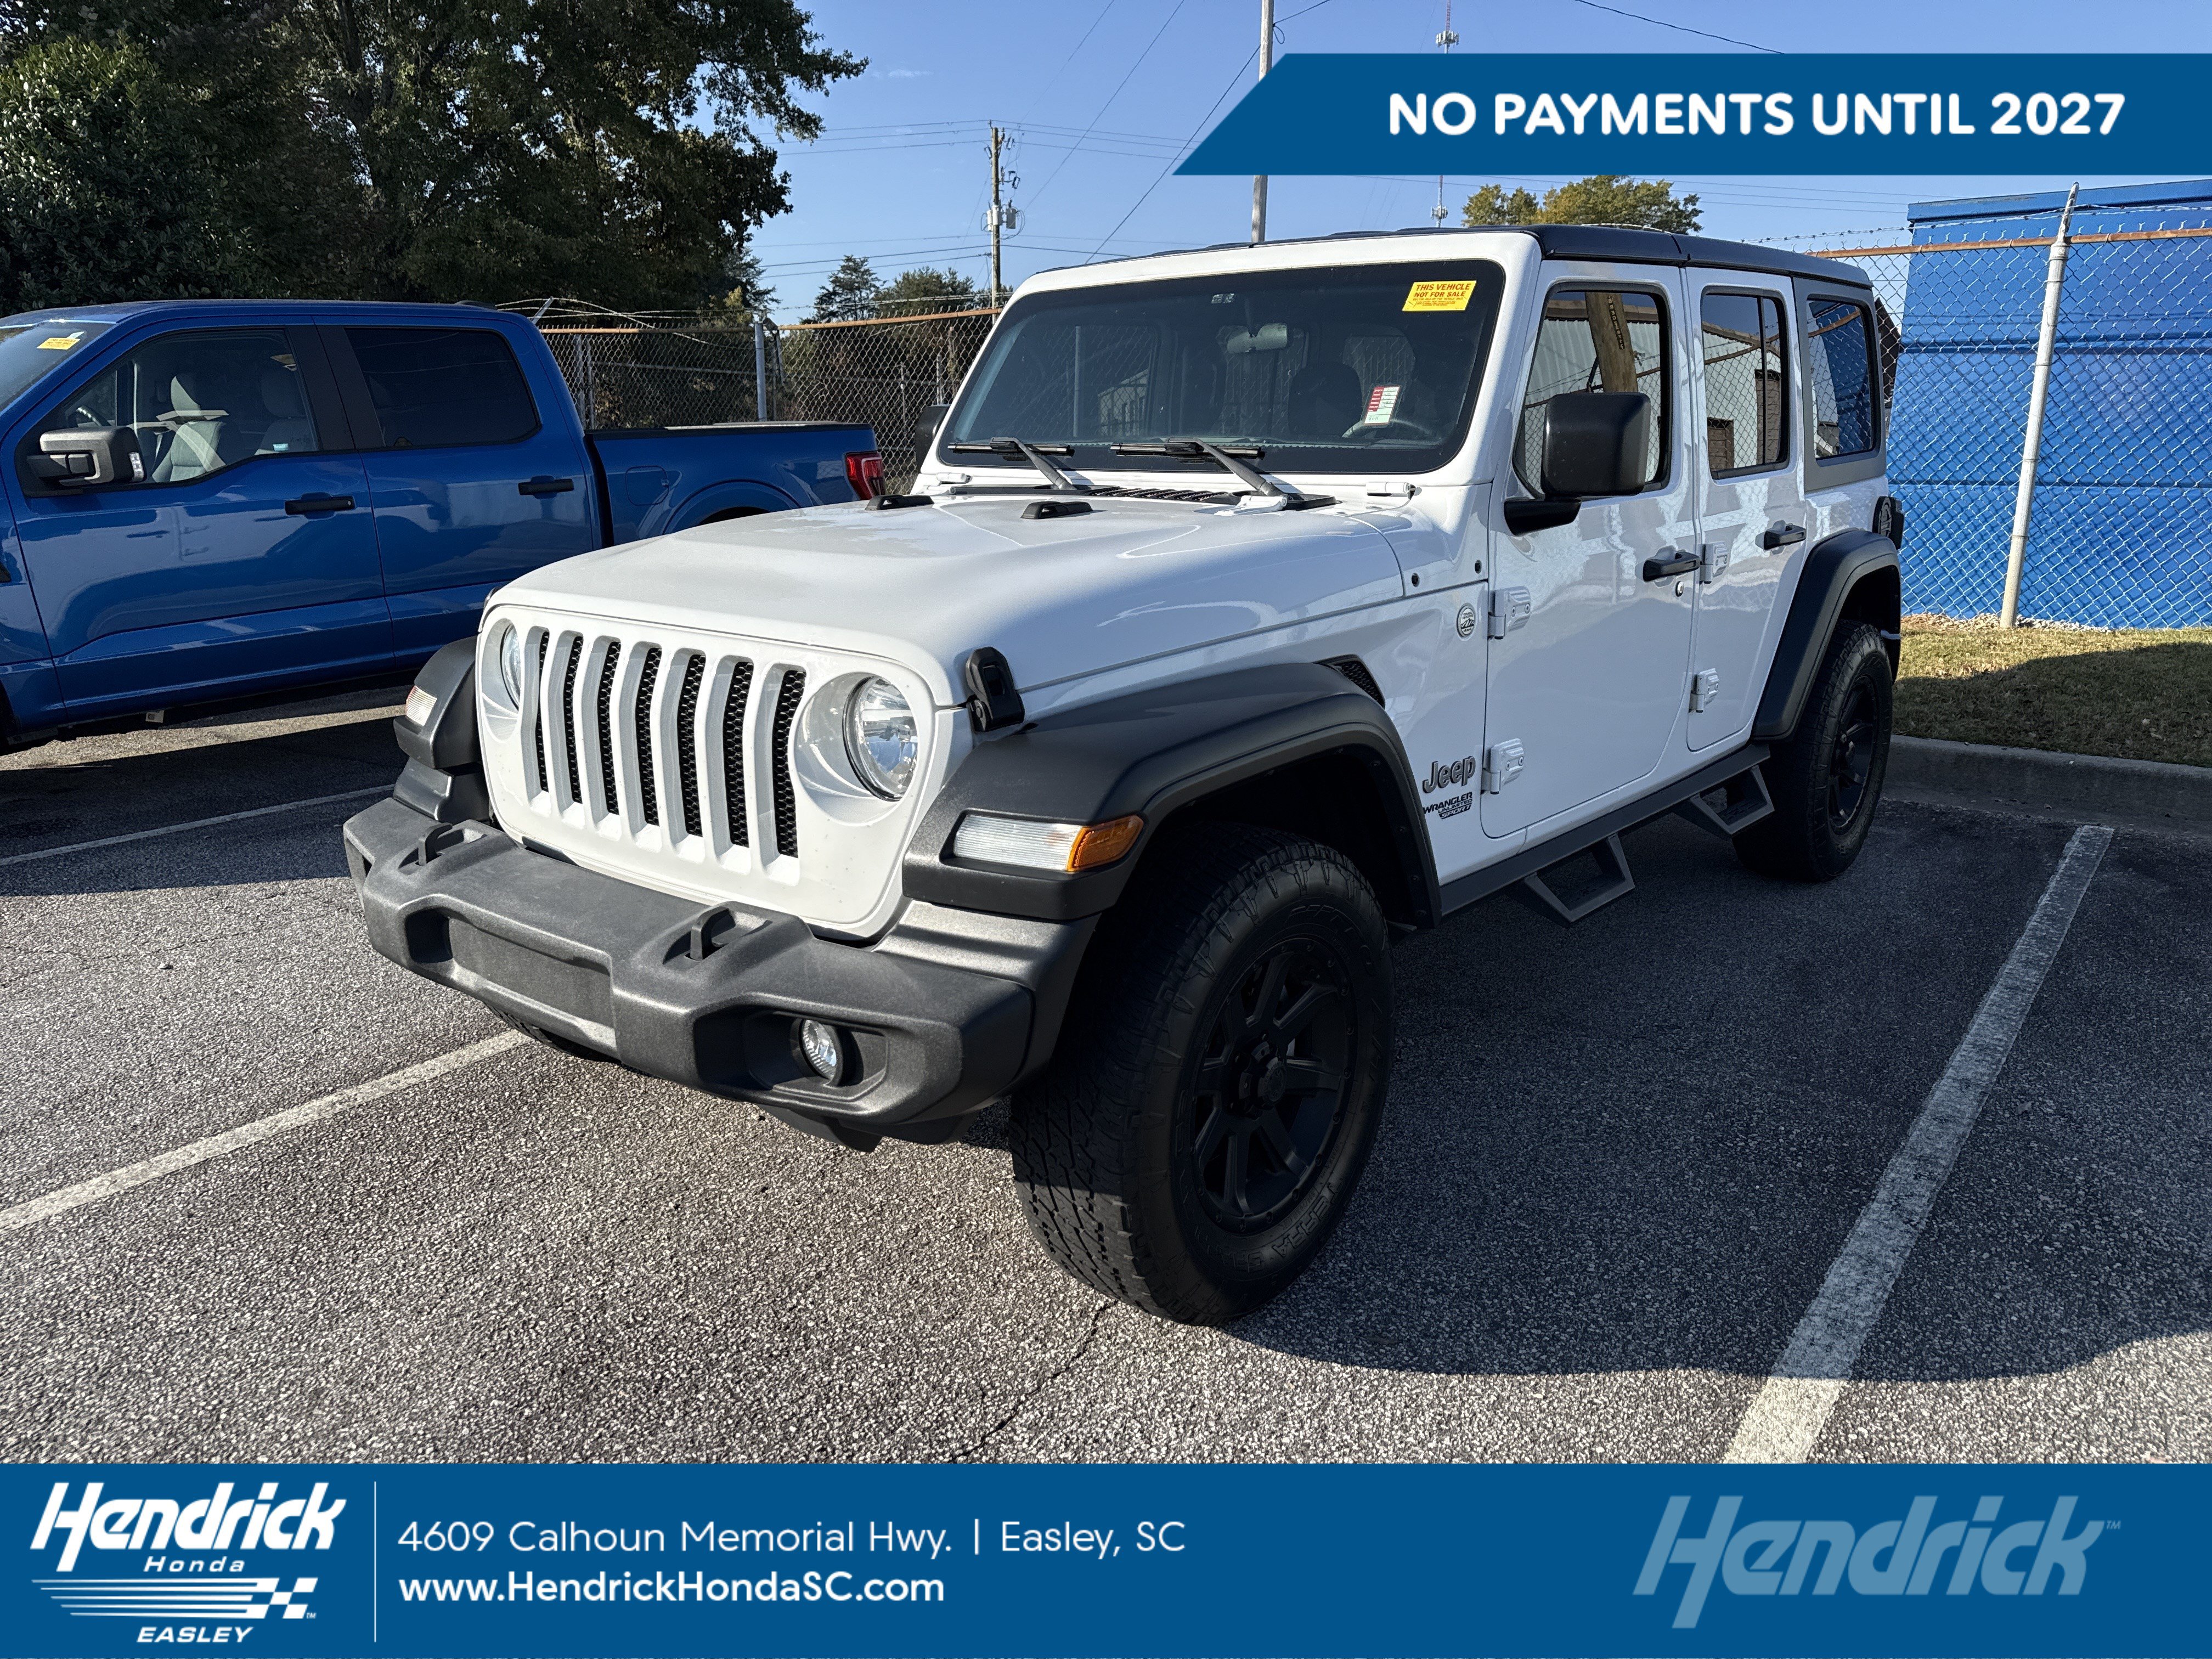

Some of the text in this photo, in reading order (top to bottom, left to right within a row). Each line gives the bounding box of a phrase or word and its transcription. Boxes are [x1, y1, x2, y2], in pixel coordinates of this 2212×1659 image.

[1422, 755, 1476, 794] Jeep
[1423, 792, 1472, 814] WRANGLER
[1438, 798, 1472, 813] UNLIMITED
[1441, 804, 1471, 817] SPORT
